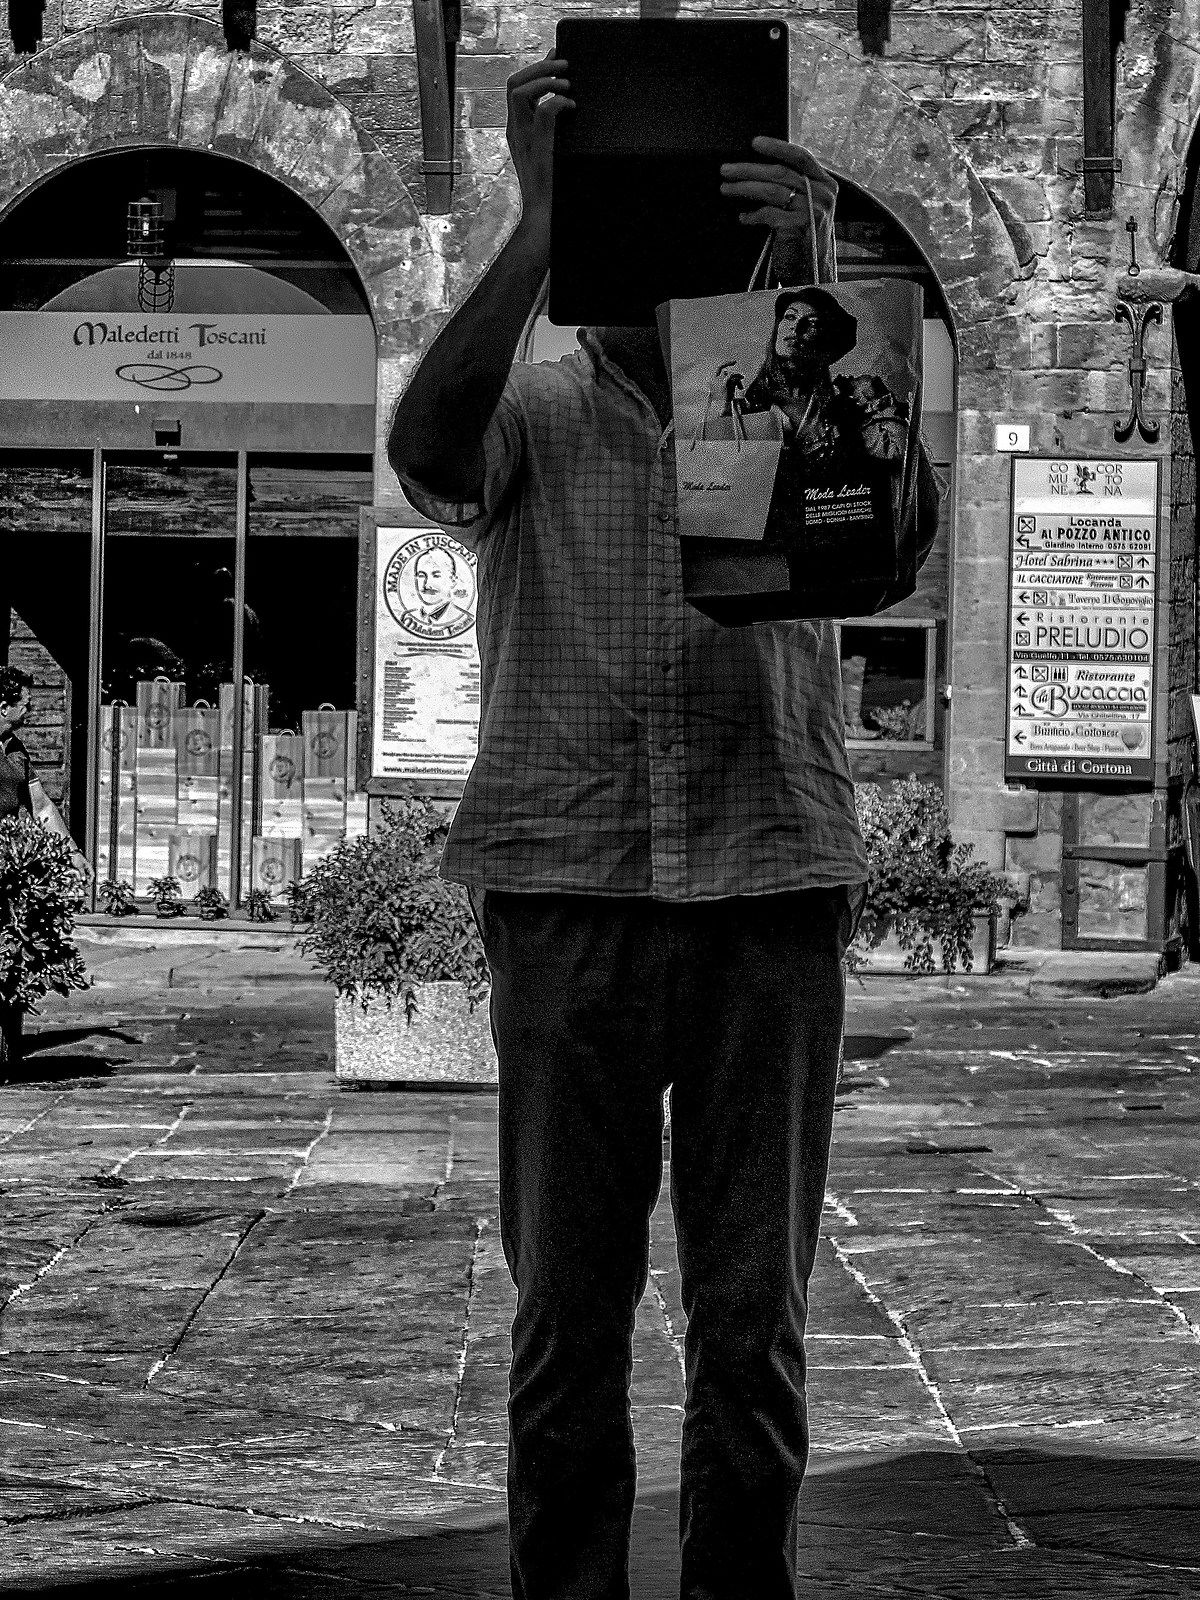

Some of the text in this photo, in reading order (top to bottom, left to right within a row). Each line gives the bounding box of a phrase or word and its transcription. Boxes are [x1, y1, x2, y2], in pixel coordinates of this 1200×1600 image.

[73, 321, 267, 347] Maledetti Toscani
[147, 350, 192, 360] dal 1848
[1008, 431, 1018, 446] 9
[1050, 463, 1068, 473] CO
[1096, 464, 1123, 474] COR
[1049, 474, 1068, 484] MU
[1106, 475, 1122, 485] TO
[804, 484, 871, 500] Moda Leader
[1051, 485, 1068, 495] NE
[1104, 486, 1122, 496] NA
[853, 500, 872, 508] STOCK
[1070, 517, 1122, 528] Locanda
[1057, 527, 1097, 541] POZZO
[1103, 529, 1151, 541] ANTICO
[1045, 541, 1076, 549] Giardino
[1079, 541, 1104, 550] Interno
[1016, 553, 1093, 568] Hotel Sabrina
[387, 552, 408, 593] MADE
[405, 541, 421, 556] IN
[1017, 574, 1084, 585] IL CACCIATORE
[1037, 612, 1150, 626] Ristorante
[1036, 626, 1149, 649] PRELUDIO
[1076, 670, 1135, 682] Ristorante
[1040, 684, 1147, 717] Bucaccia
[1027, 760, 1132, 774] Città di Cortona
